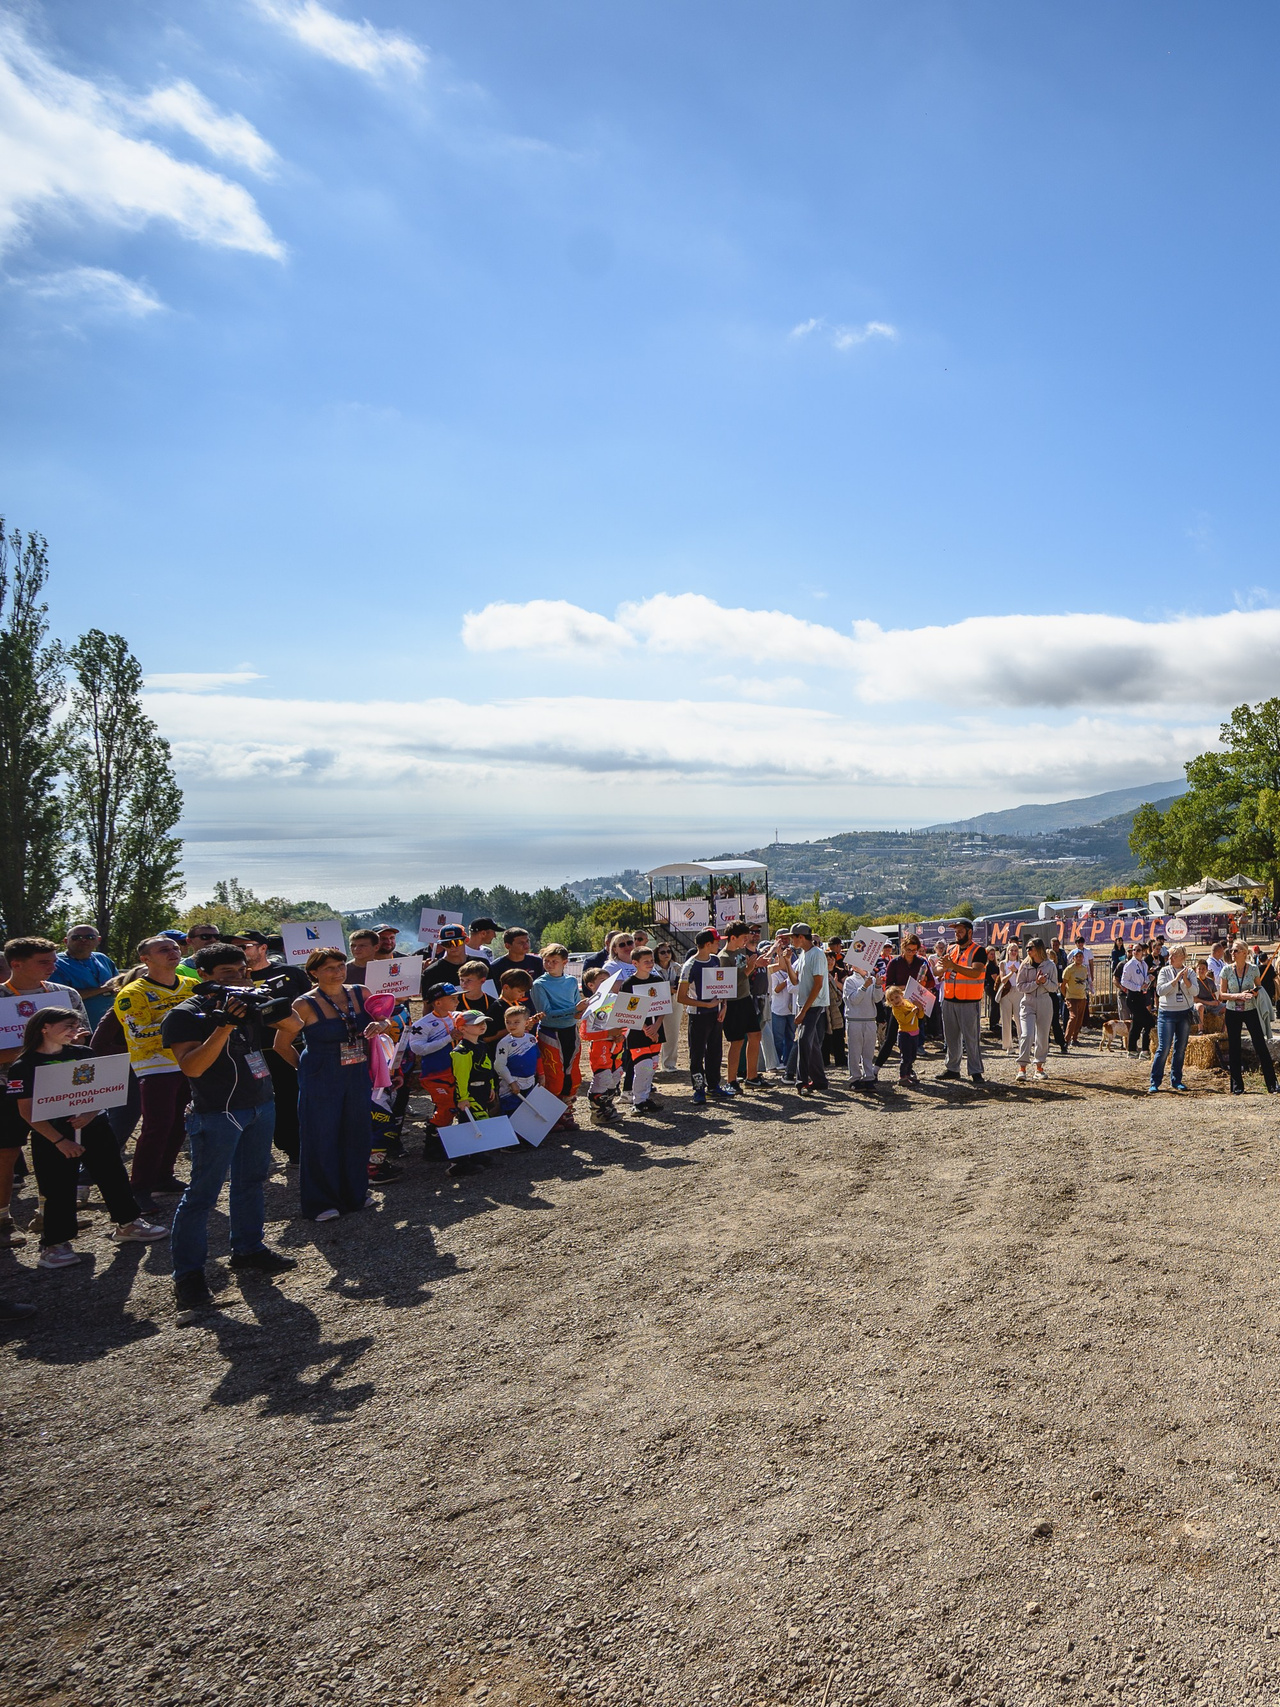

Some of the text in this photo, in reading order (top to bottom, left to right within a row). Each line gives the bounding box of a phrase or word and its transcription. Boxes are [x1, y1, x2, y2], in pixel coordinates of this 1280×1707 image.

[382, 980, 404, 988] САНКТ-
[615, 1012, 642, 1020] ХЕРСОНСКАЯ
[37, 1083, 125, 1105] СТАВРОПОЛЬСКИЙ
[69, 1096, 94, 1107] КРАЙ
